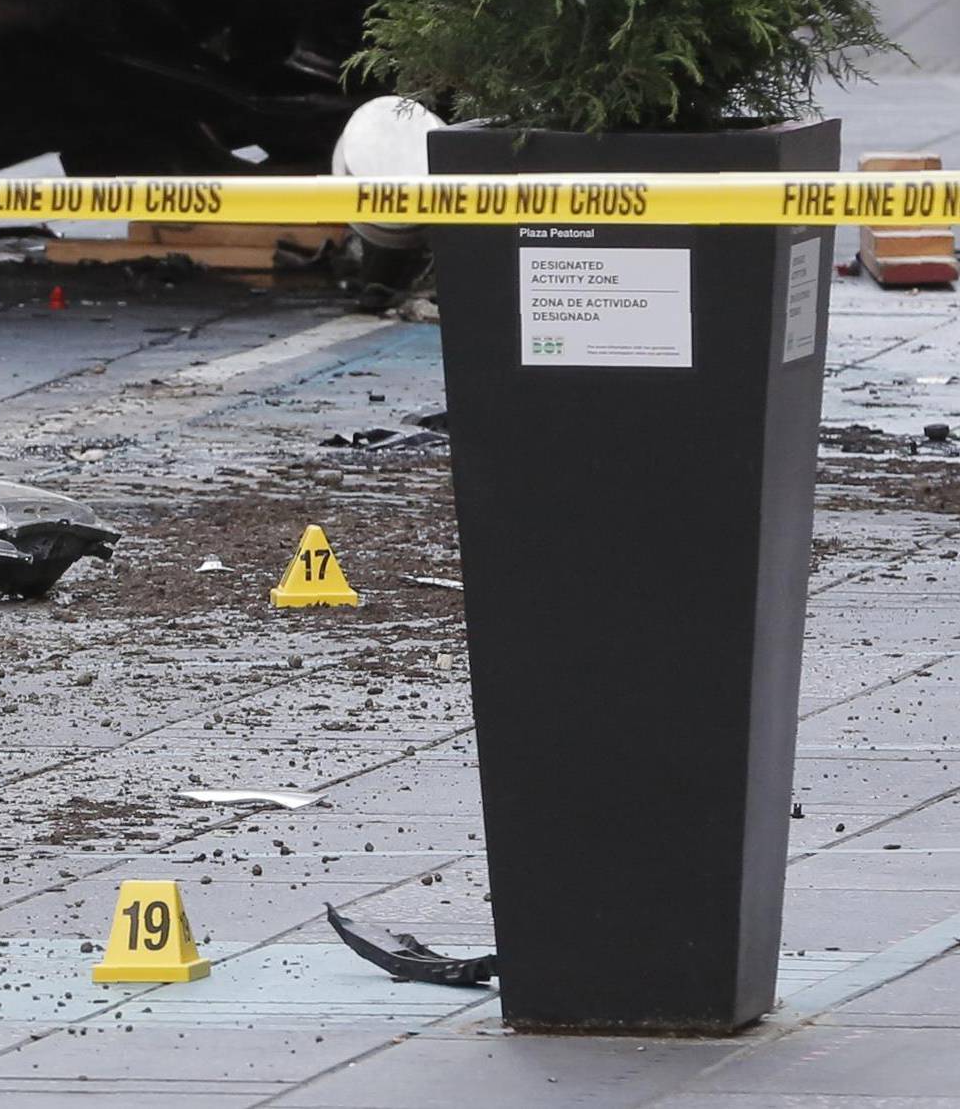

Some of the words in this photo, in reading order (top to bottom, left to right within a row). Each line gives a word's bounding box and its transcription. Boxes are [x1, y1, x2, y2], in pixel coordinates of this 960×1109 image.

[51, 181, 83, 213] DO
[91, 181, 137, 213] NOT
[146, 181, 223, 214] CROSS
[356, 181, 409, 213] FIRE
[417, 181, 468, 214] LINE
[476, 182, 507, 215] DO
[515, 181, 563, 215] NOT
[570, 182, 648, 215] CROSS
[783, 182, 836, 216] FIRE
[844, 182, 895, 216] LINE
[903, 182, 935, 217] DO
[519, 227, 548, 238] Plaza
[550, 228, 595, 238] Peatonal
[531, 260, 604, 271] DESIGNATED
[531, 274, 584, 284] ACTIVITY
[587, 275, 619, 285] ZONE
[532, 298, 564, 308] ZONA
[567, 298, 583, 308] DE
[586, 298, 648, 309] ACTIVIDAD
[532, 312, 600, 322] DESIGNADA
[300, 549, 331, 582] 17
[122, 900, 171, 951] 19
